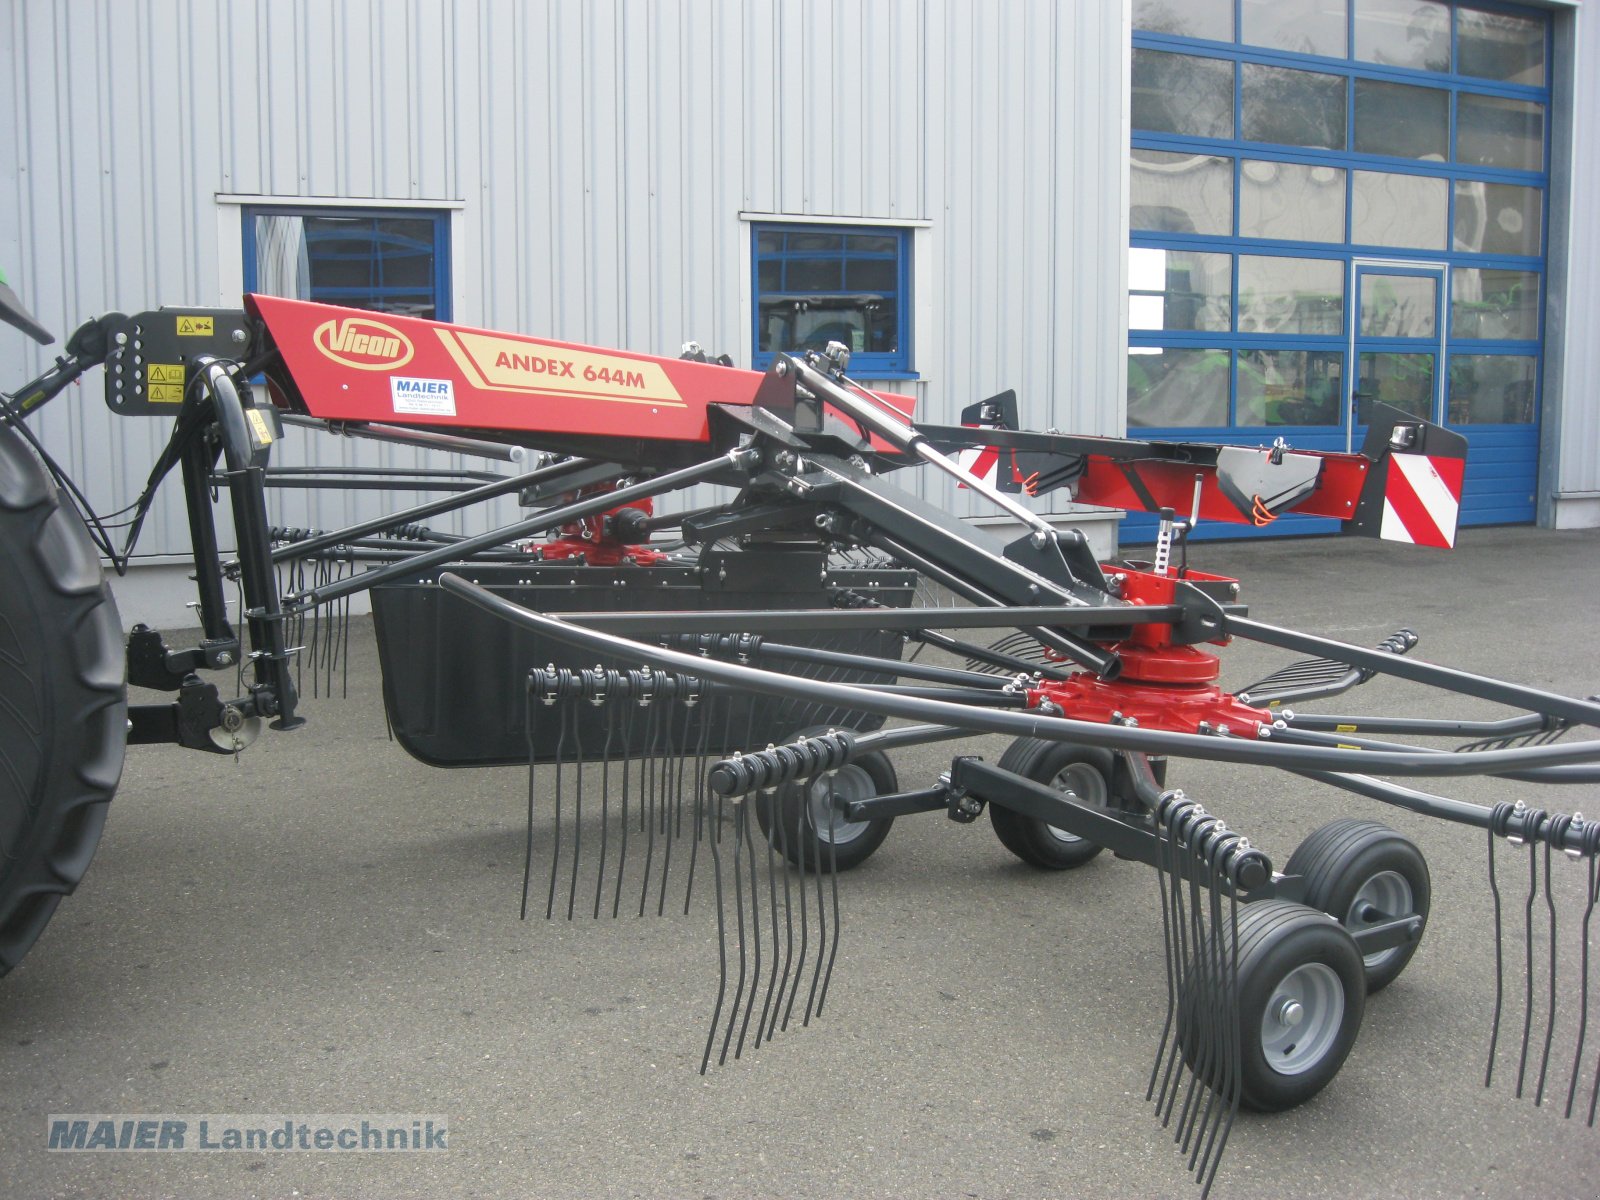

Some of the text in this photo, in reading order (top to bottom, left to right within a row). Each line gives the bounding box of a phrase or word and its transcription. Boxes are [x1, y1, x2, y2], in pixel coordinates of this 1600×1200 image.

[327, 318, 401, 358] Vicon
[495, 351, 645, 389] ANDEX 644M
[396, 380, 448, 394] MAIER
[397, 392, 449, 401] Landtechnik
